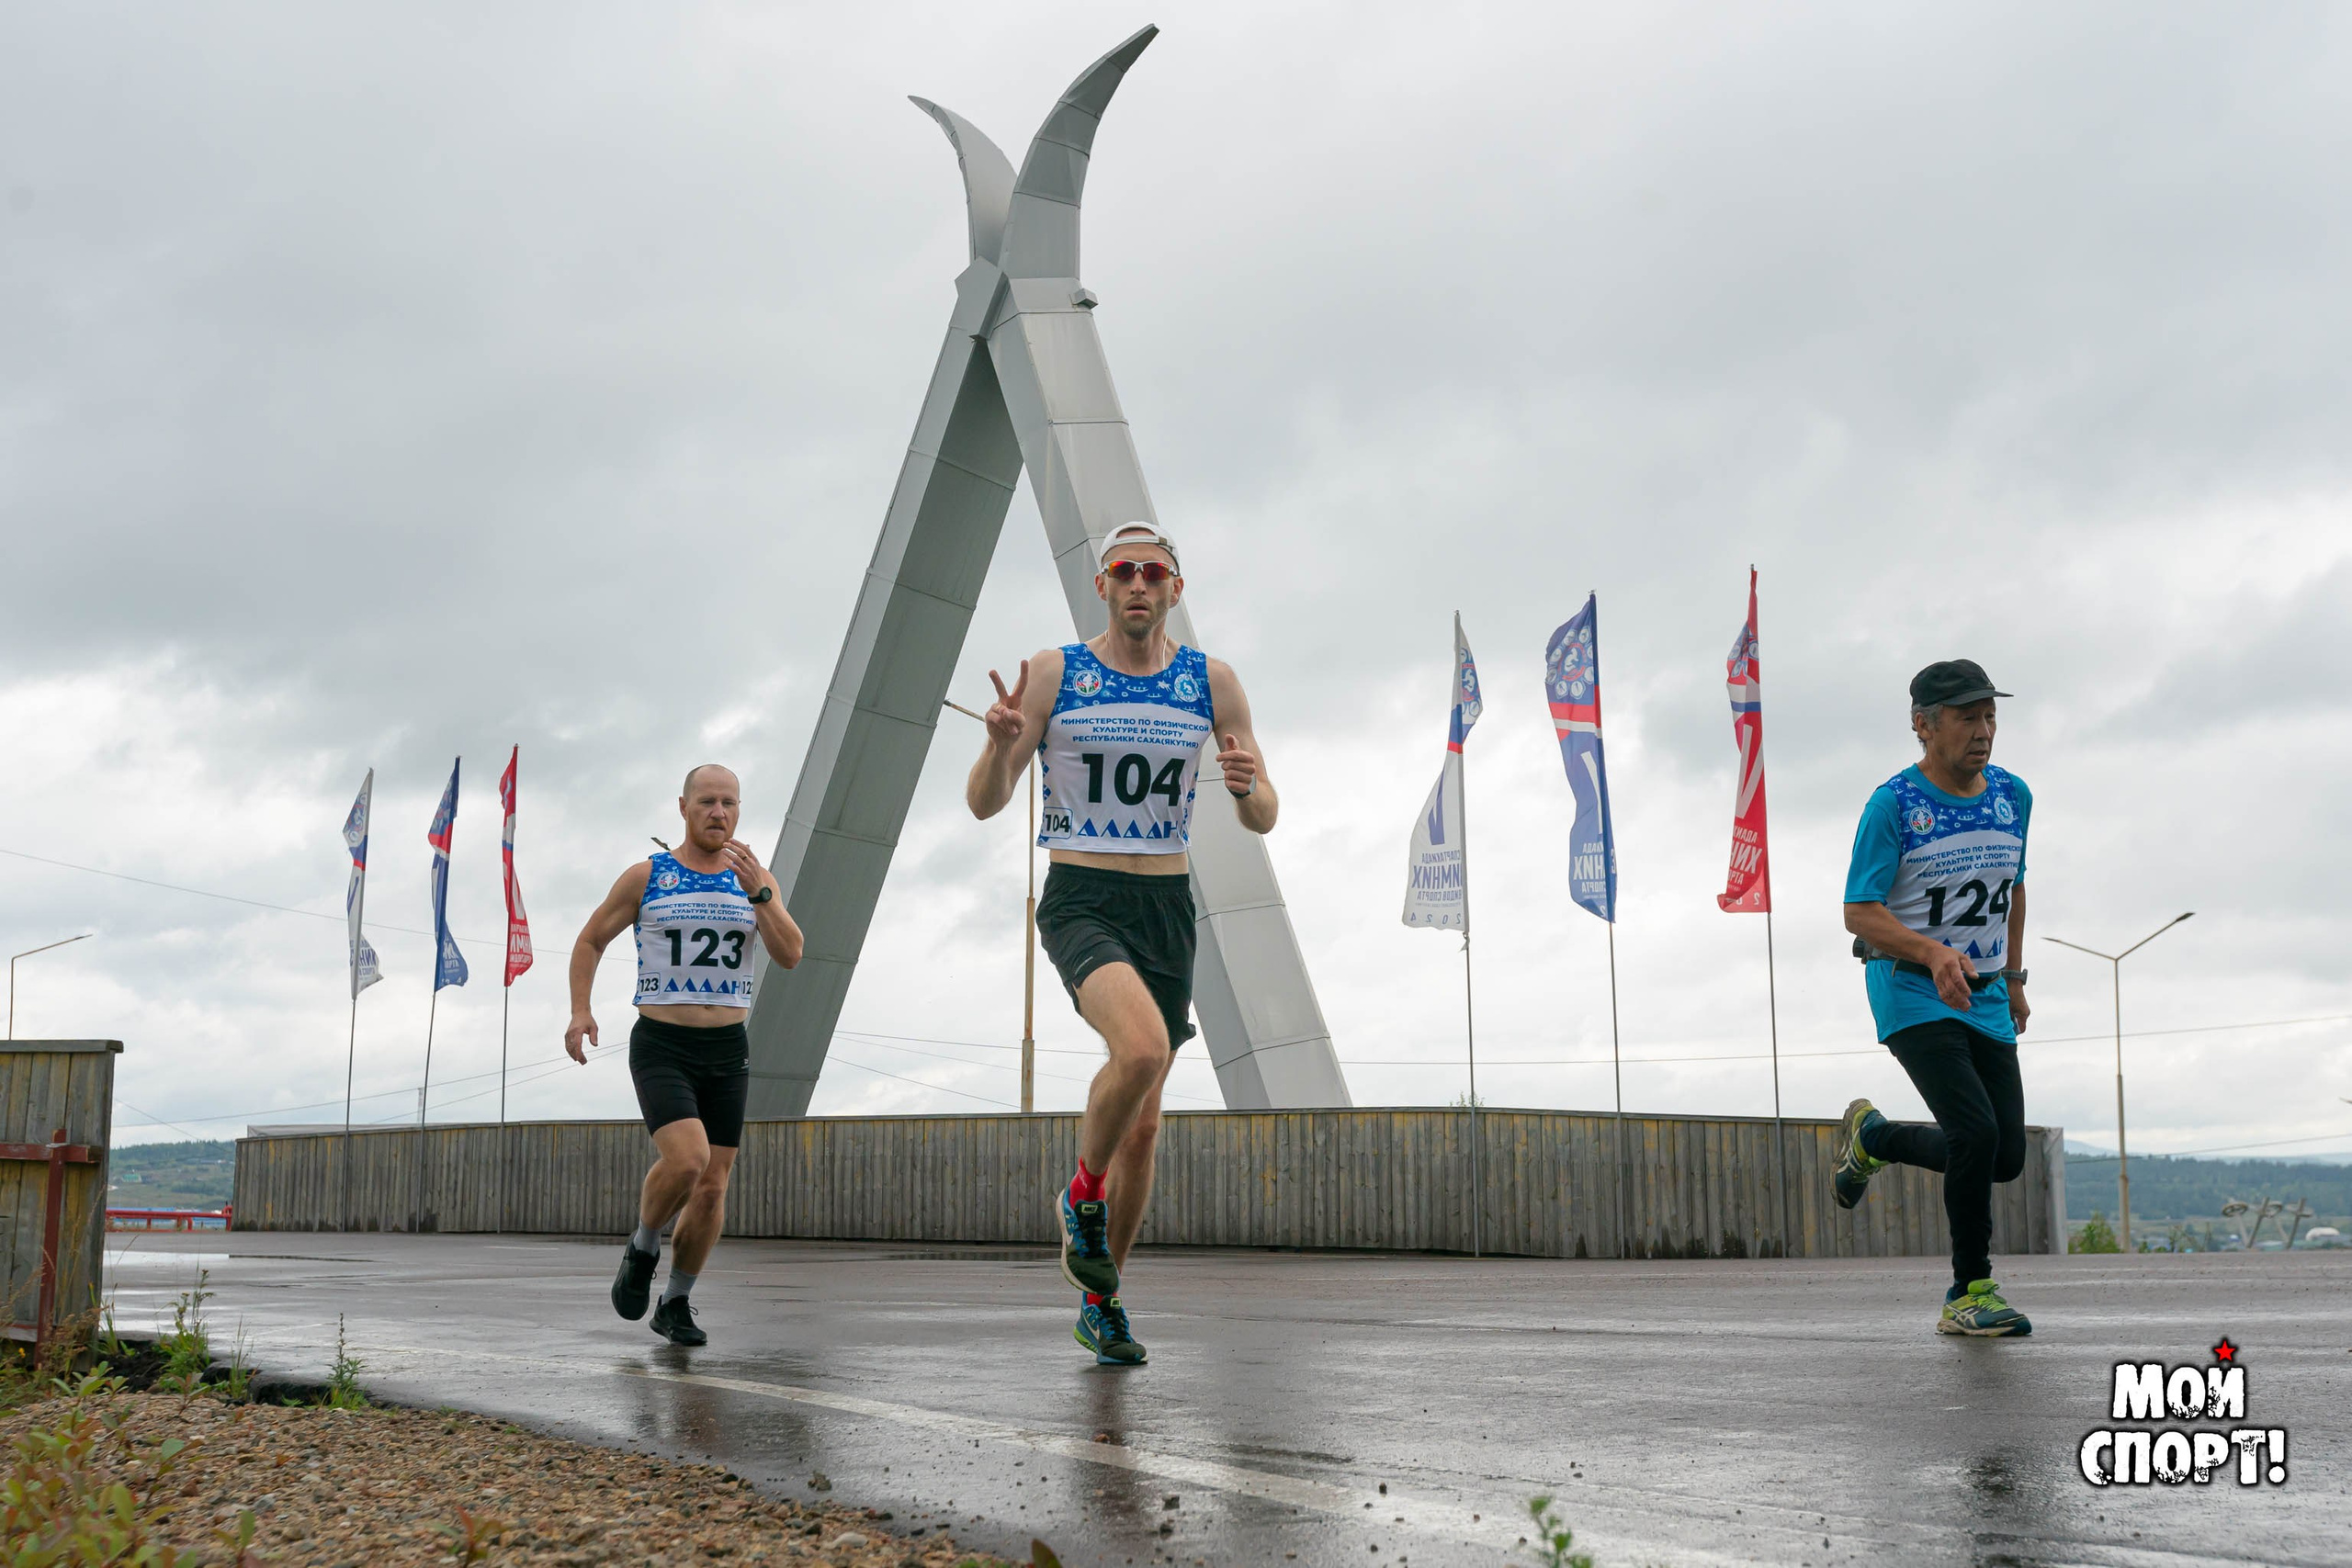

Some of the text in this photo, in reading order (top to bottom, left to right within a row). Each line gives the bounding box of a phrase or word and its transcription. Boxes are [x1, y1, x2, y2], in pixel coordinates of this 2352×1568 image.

[1061, 717, 1136, 726] МИНИСТЕРСТВО
[1153, 718, 1209, 732] ФИЗИЧЕСКОЙ
[1092, 726, 1183, 738] КУЛЬТУРЕ И СПОРТУ
[1137, 737, 1199, 749] САХА(ЯКУТИЯ)
[1081, 753, 1187, 807] 104
[1046, 814, 1071, 833] 104
[1906, 847, 1971, 863] МИНИСТЕРСТВО
[1935, 855, 1974, 868] КУЛЬТУРЕ
[1917, 863, 1973, 878] РЕСПУБЛИКИ
[648, 902, 707, 911] МИНИСТЕРСТВО
[1925, 878, 2014, 927] 124
[664, 928, 746, 970] 123
[640, 977, 659, 992] 123
[742, 980, 753, 994] 12
